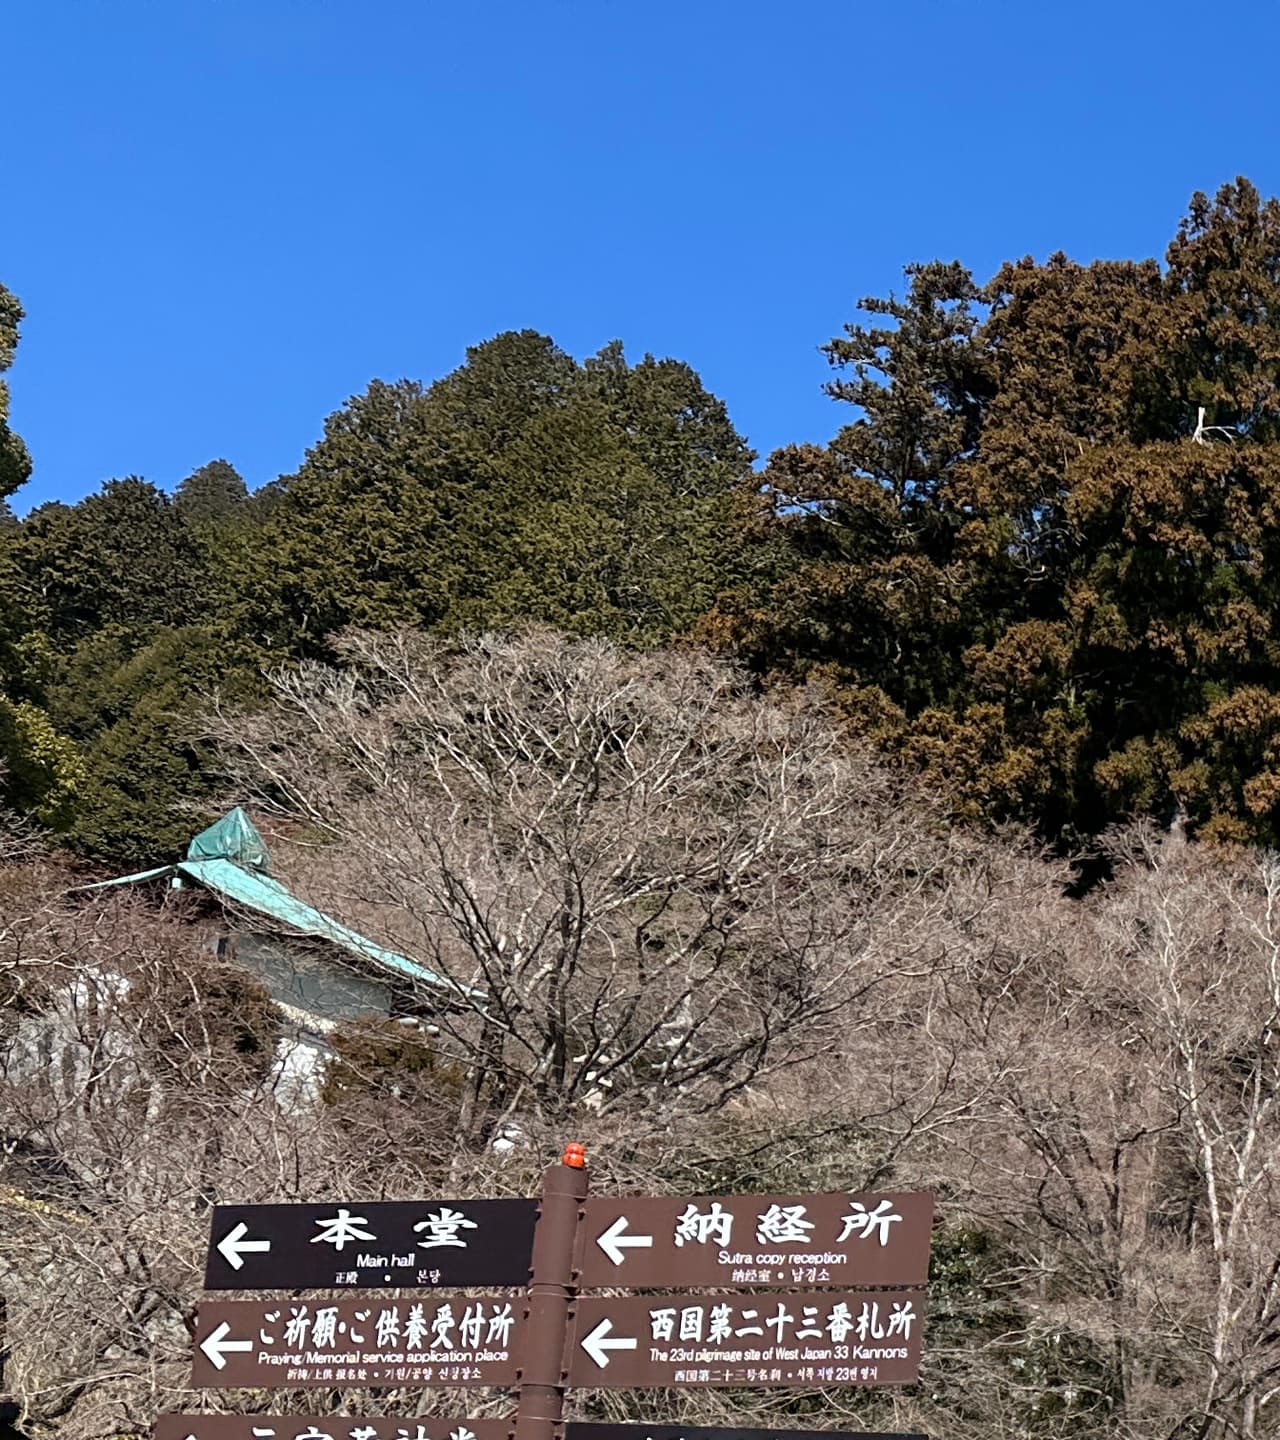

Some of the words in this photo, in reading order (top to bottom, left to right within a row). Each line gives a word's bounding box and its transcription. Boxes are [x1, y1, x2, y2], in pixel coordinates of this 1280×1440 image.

[310, 1207, 479, 1251] 本堂
[672, 1200, 903, 1248] 納経所
[356, 1253, 388, 1268] Main
[390, 1252, 416, 1267] hall
[717, 1250, 753, 1265] Sutra
[755, 1253, 786, 1266] copy
[788, 1251, 848, 1266] reception
[649, 1300, 917, 1345] 西国第二十三番札所
[362, 1350, 405, 1364] service
[406, 1348, 473, 1364] application
[474, 1347, 509, 1362] place
[649, 1347, 669, 1362] The
[669, 1347, 695, 1362] 23rd
[694, 1347, 743, 1363] pilgrimage
[743, 1347, 761, 1361] site
[762, 1346, 775, 1361] of
[775, 1346, 800, 1361] West
[800, 1346, 833, 1361] Japan
[833, 1344, 849, 1360] 33
[852, 1344, 908, 1360] Kannons
